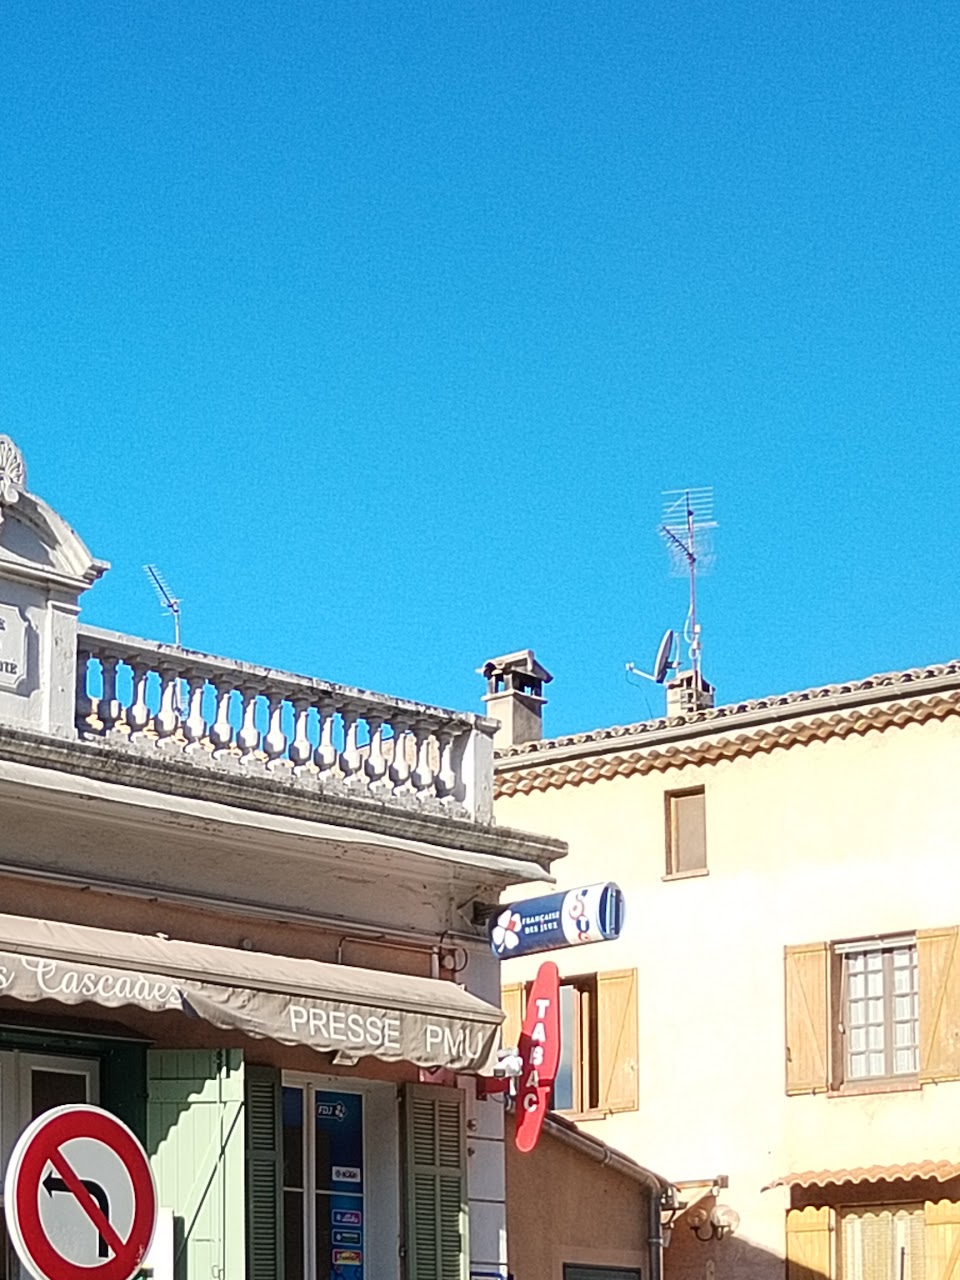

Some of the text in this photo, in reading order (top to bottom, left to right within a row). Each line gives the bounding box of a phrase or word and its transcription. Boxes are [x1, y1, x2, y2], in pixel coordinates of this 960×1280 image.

[524, 925, 539, 935] DES
[20, 955, 189, 1004] Cascades
[289, 1004, 484, 1060] PRESSE PMU
[523, 998, 551, 1113] TABAC
[317, 1105, 333, 1116] FDJ
